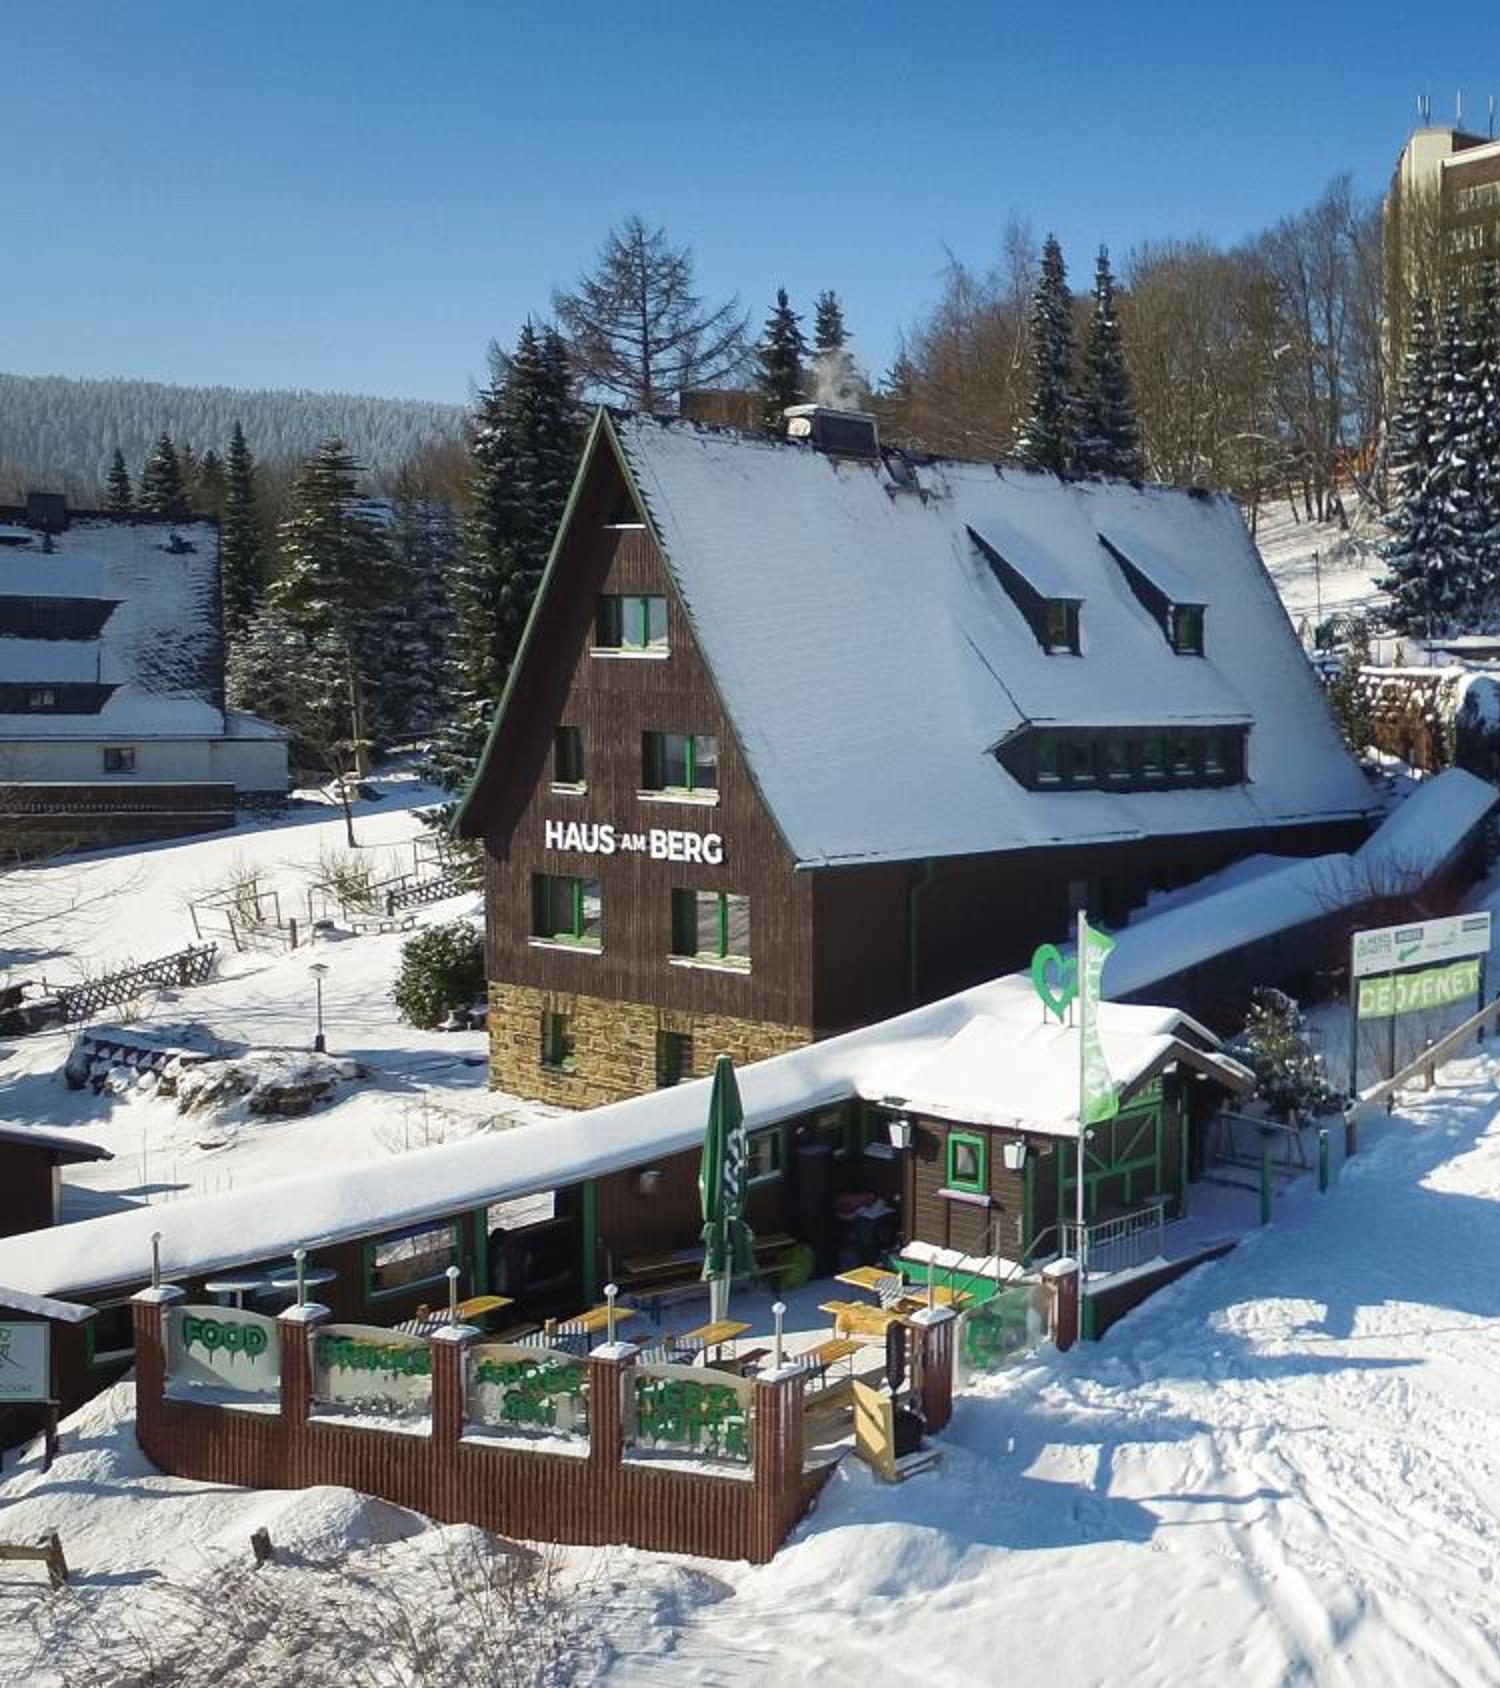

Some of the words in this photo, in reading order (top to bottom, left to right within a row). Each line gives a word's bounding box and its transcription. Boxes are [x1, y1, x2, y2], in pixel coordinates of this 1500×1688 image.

[545, 819, 615, 855] HAUS
[621, 833, 646, 851] AM
[649, 829, 724, 864] BERG
[182, 1315, 268, 1357] FOOD
